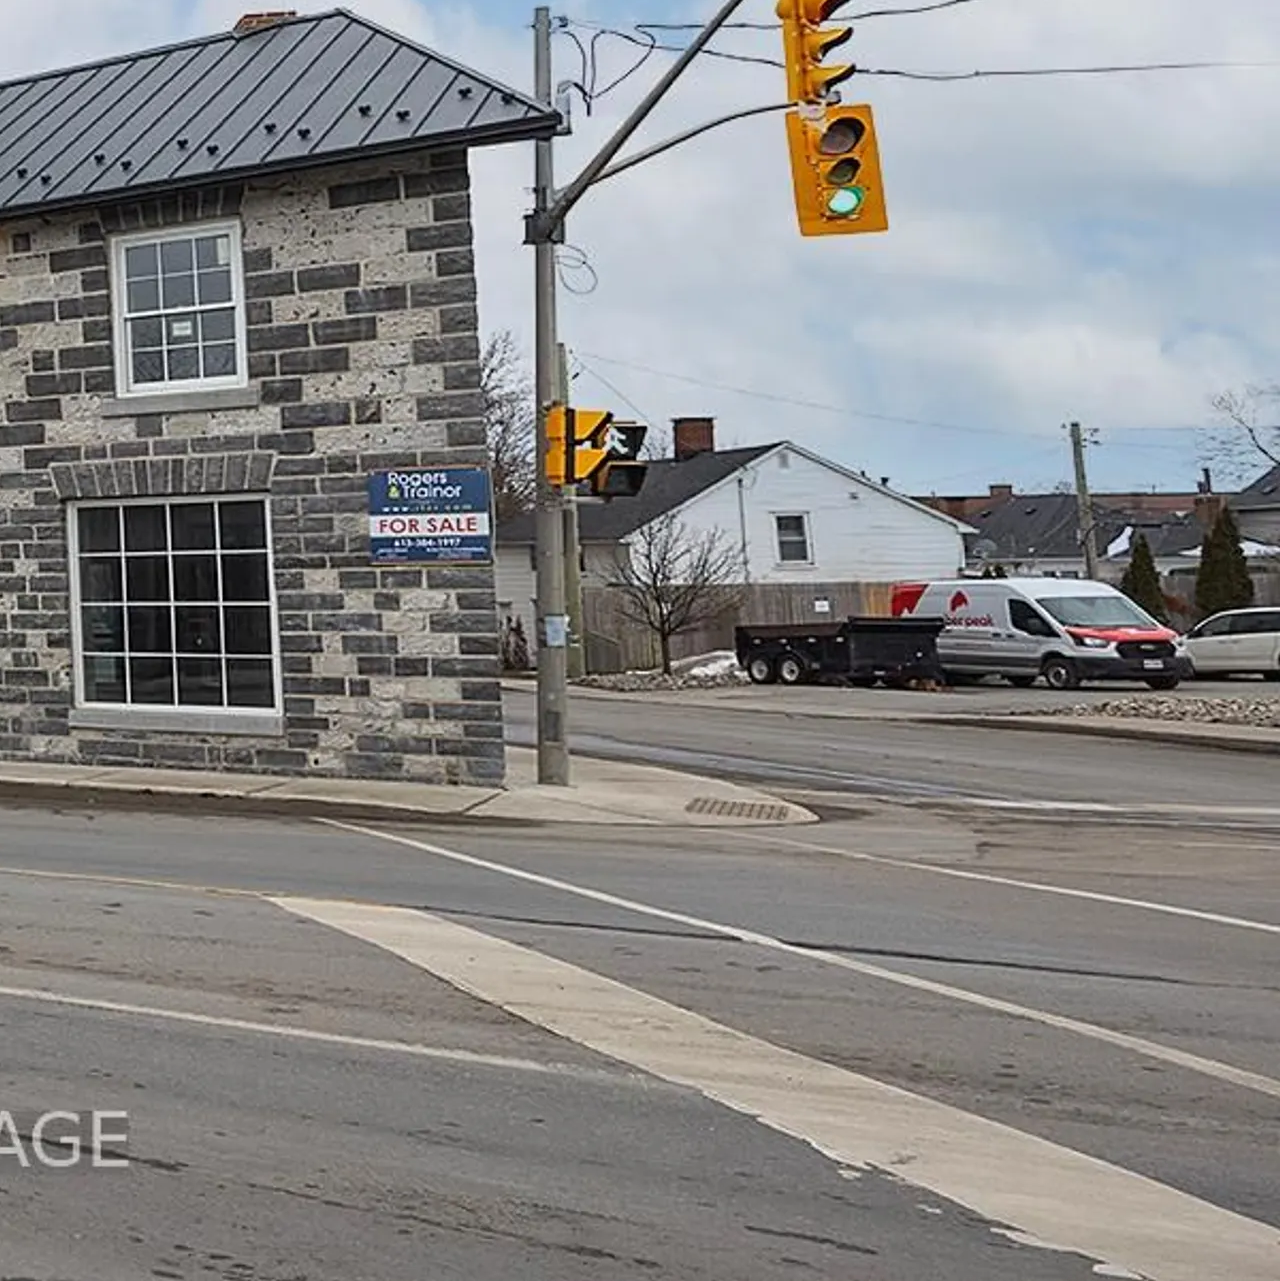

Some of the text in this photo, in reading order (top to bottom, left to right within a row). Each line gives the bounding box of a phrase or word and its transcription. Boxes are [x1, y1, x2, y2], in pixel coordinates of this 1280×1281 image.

[387, 472, 447, 486] Rogers
[403, 485, 462, 499] Trainor
[380, 516, 477, 534] FOR SALE
